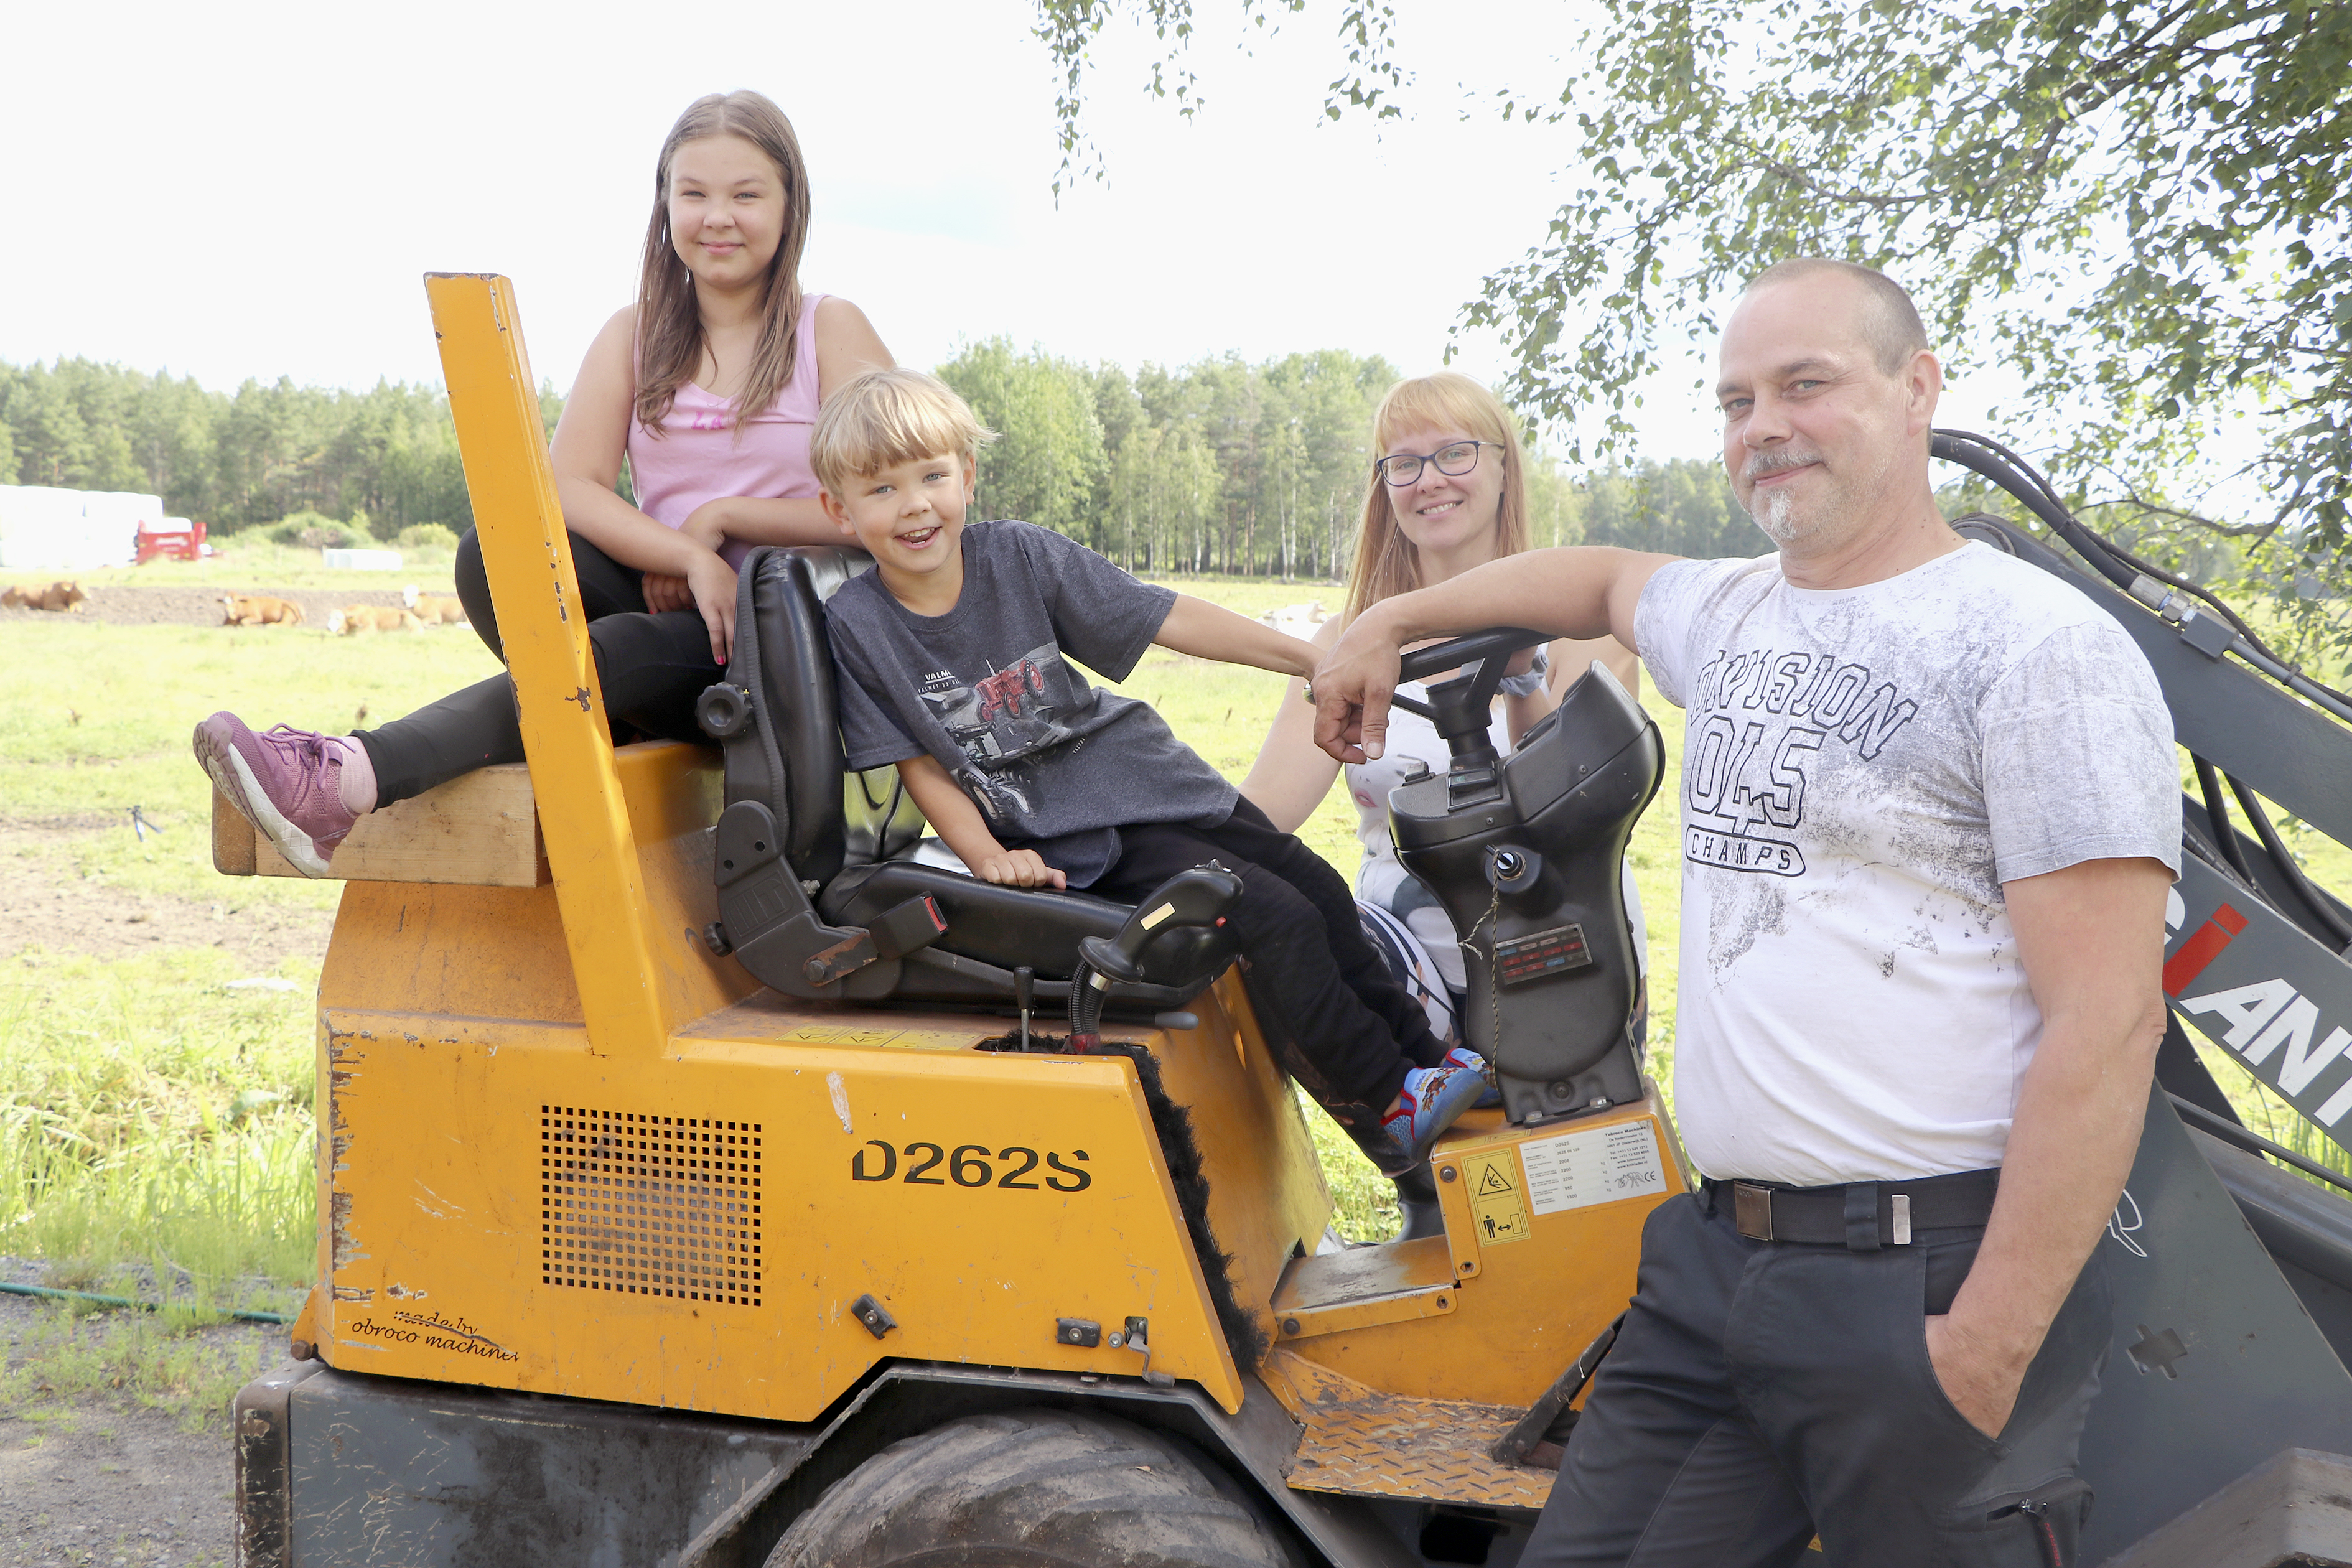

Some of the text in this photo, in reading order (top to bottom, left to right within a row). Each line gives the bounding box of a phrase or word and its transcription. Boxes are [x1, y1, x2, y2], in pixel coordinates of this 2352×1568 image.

[1692, 834, 1791, 870] CHAMPS
[852, 1139, 1092, 1192] D262S
[1645, 1171, 1656, 1182] CE
